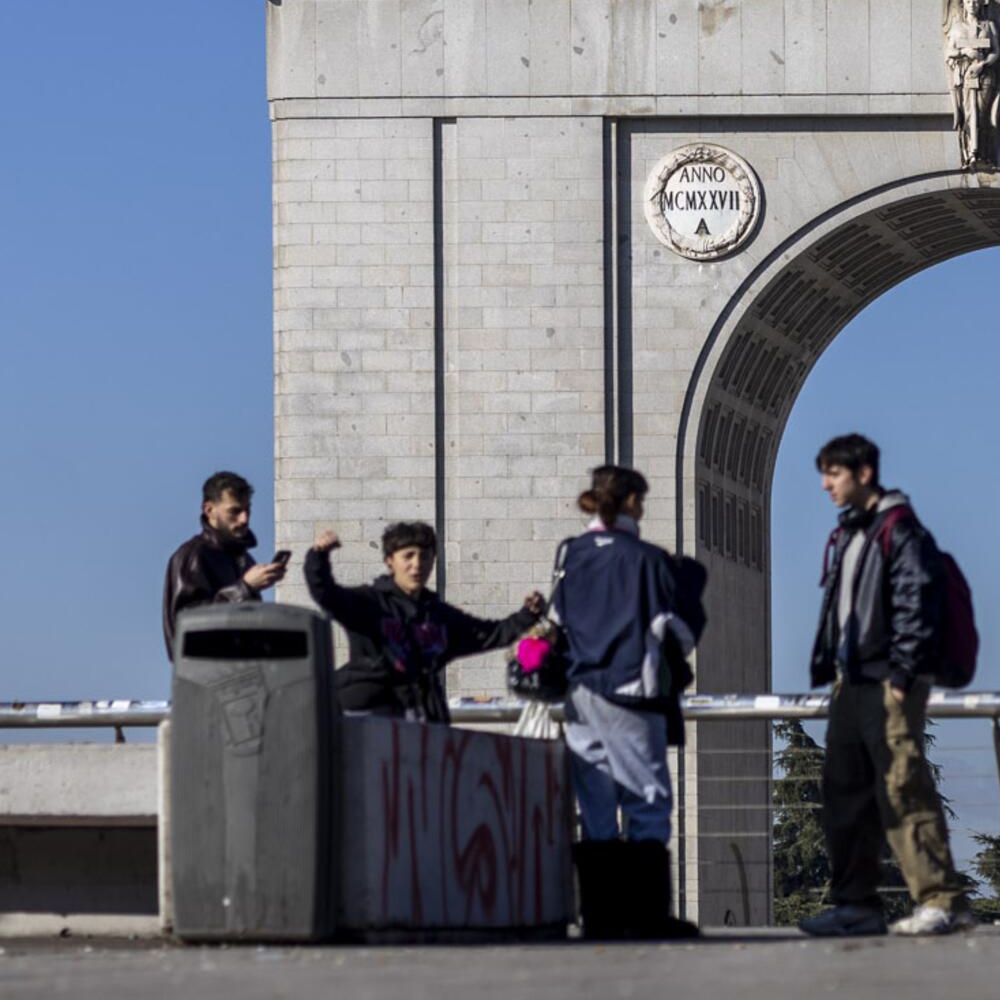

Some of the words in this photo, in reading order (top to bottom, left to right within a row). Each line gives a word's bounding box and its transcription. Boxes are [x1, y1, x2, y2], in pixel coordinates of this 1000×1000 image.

[678, 166, 725, 183] ANNO
[662, 190, 740, 212] MCMXXVII
[694, 217, 711, 236] A
